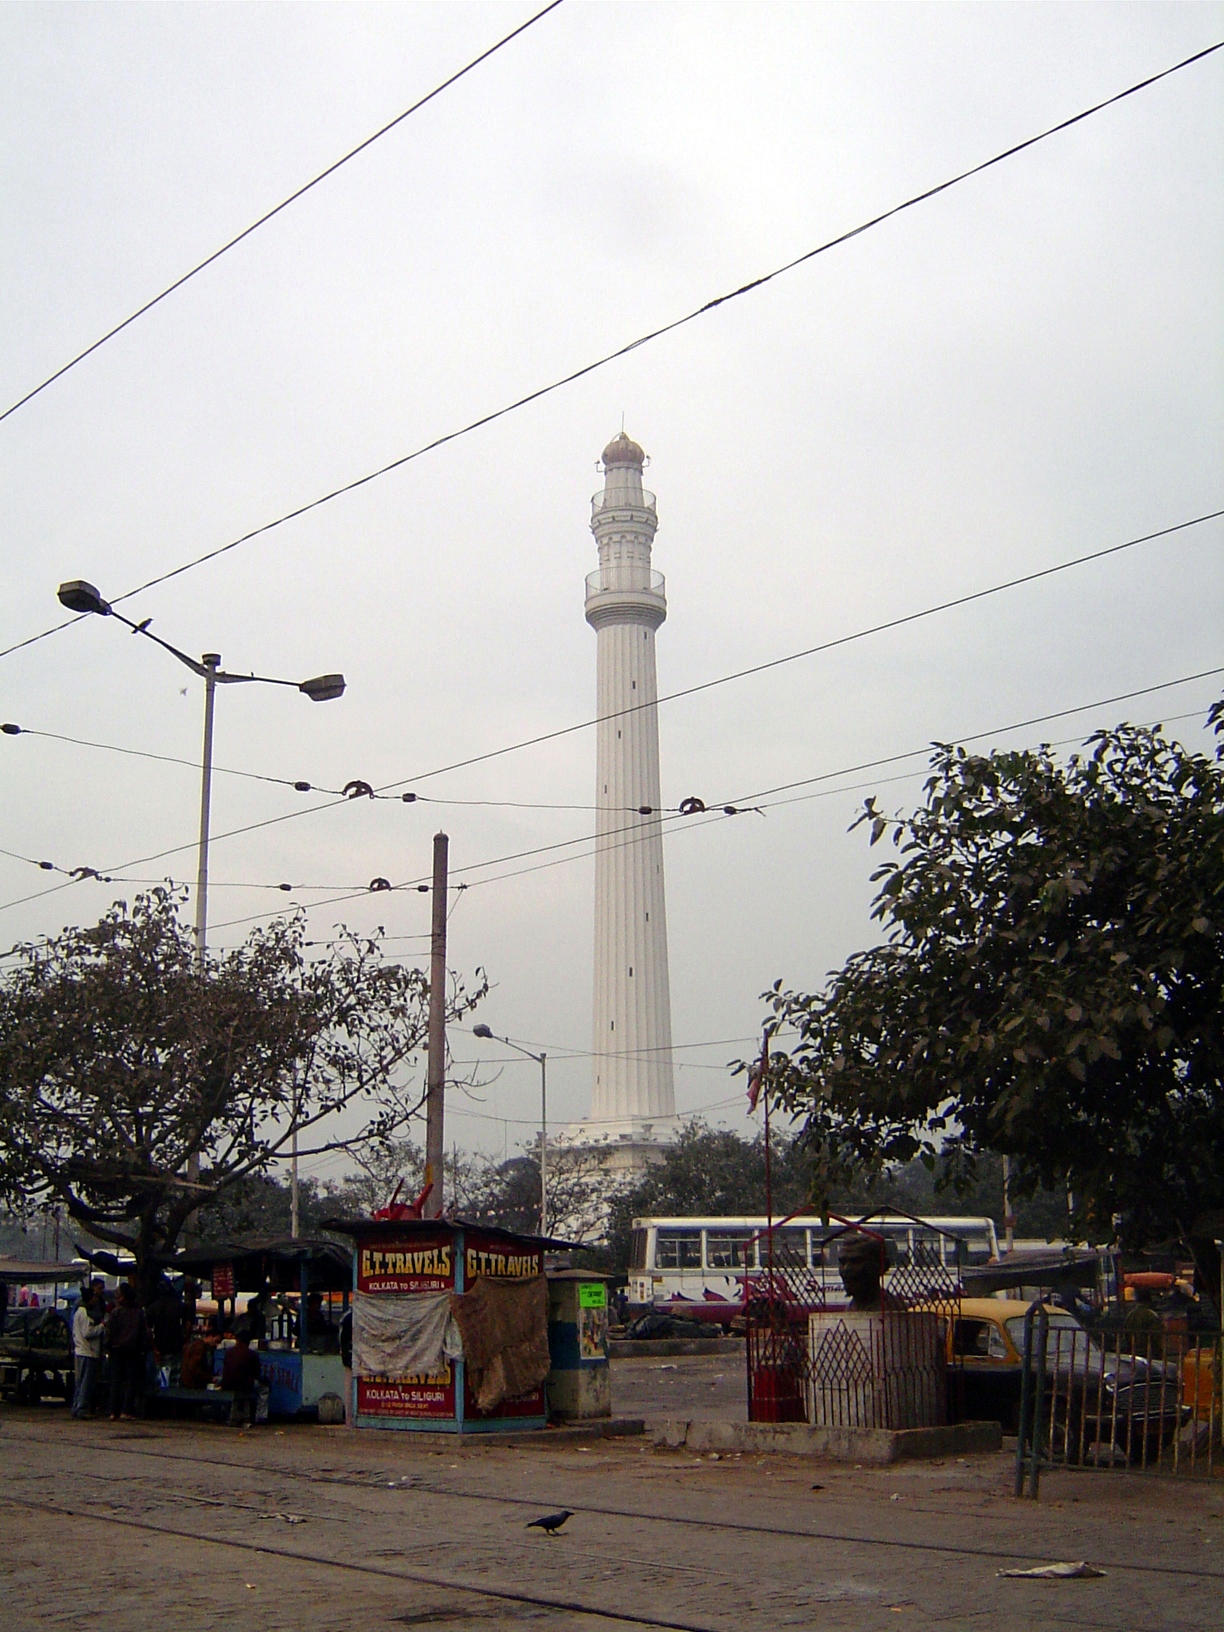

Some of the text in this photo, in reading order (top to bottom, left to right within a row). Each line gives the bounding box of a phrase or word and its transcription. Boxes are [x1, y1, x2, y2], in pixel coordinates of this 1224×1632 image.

[368, 1281, 399, 1291] KOLKATA
[400, 1282, 408, 1290] TO
[409, 1280, 440, 1290] SILIGURI
[366, 1389, 399, 1400] KOLKATA
[411, 1391, 445, 1402] SILIGURI
